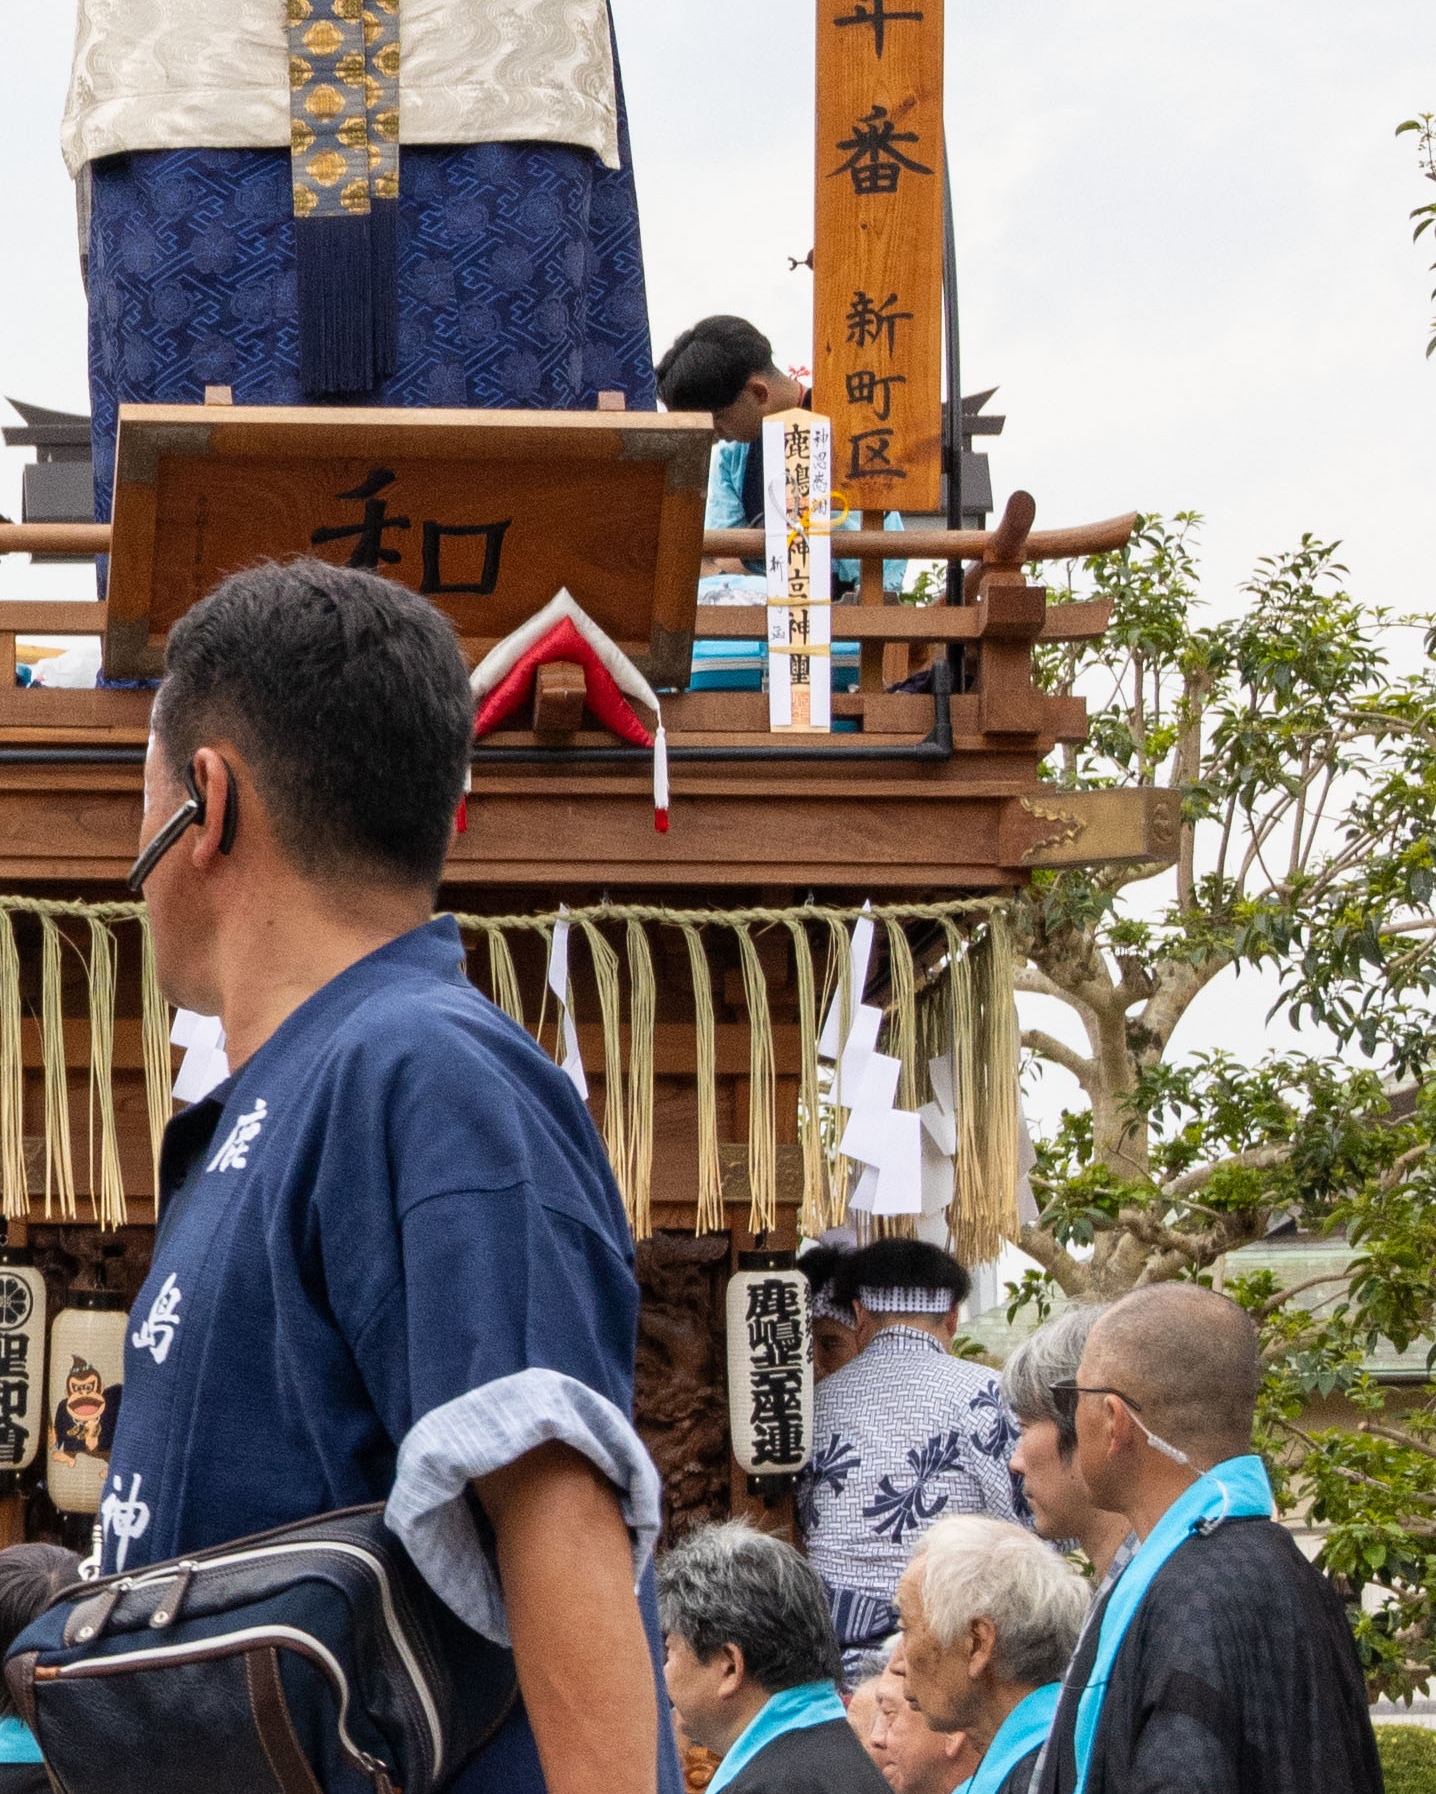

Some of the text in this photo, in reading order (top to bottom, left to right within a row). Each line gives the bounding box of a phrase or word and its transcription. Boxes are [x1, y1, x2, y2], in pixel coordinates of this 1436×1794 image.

[844, 290, 915, 480] 新町区
[310, 469, 514, 596] 和
